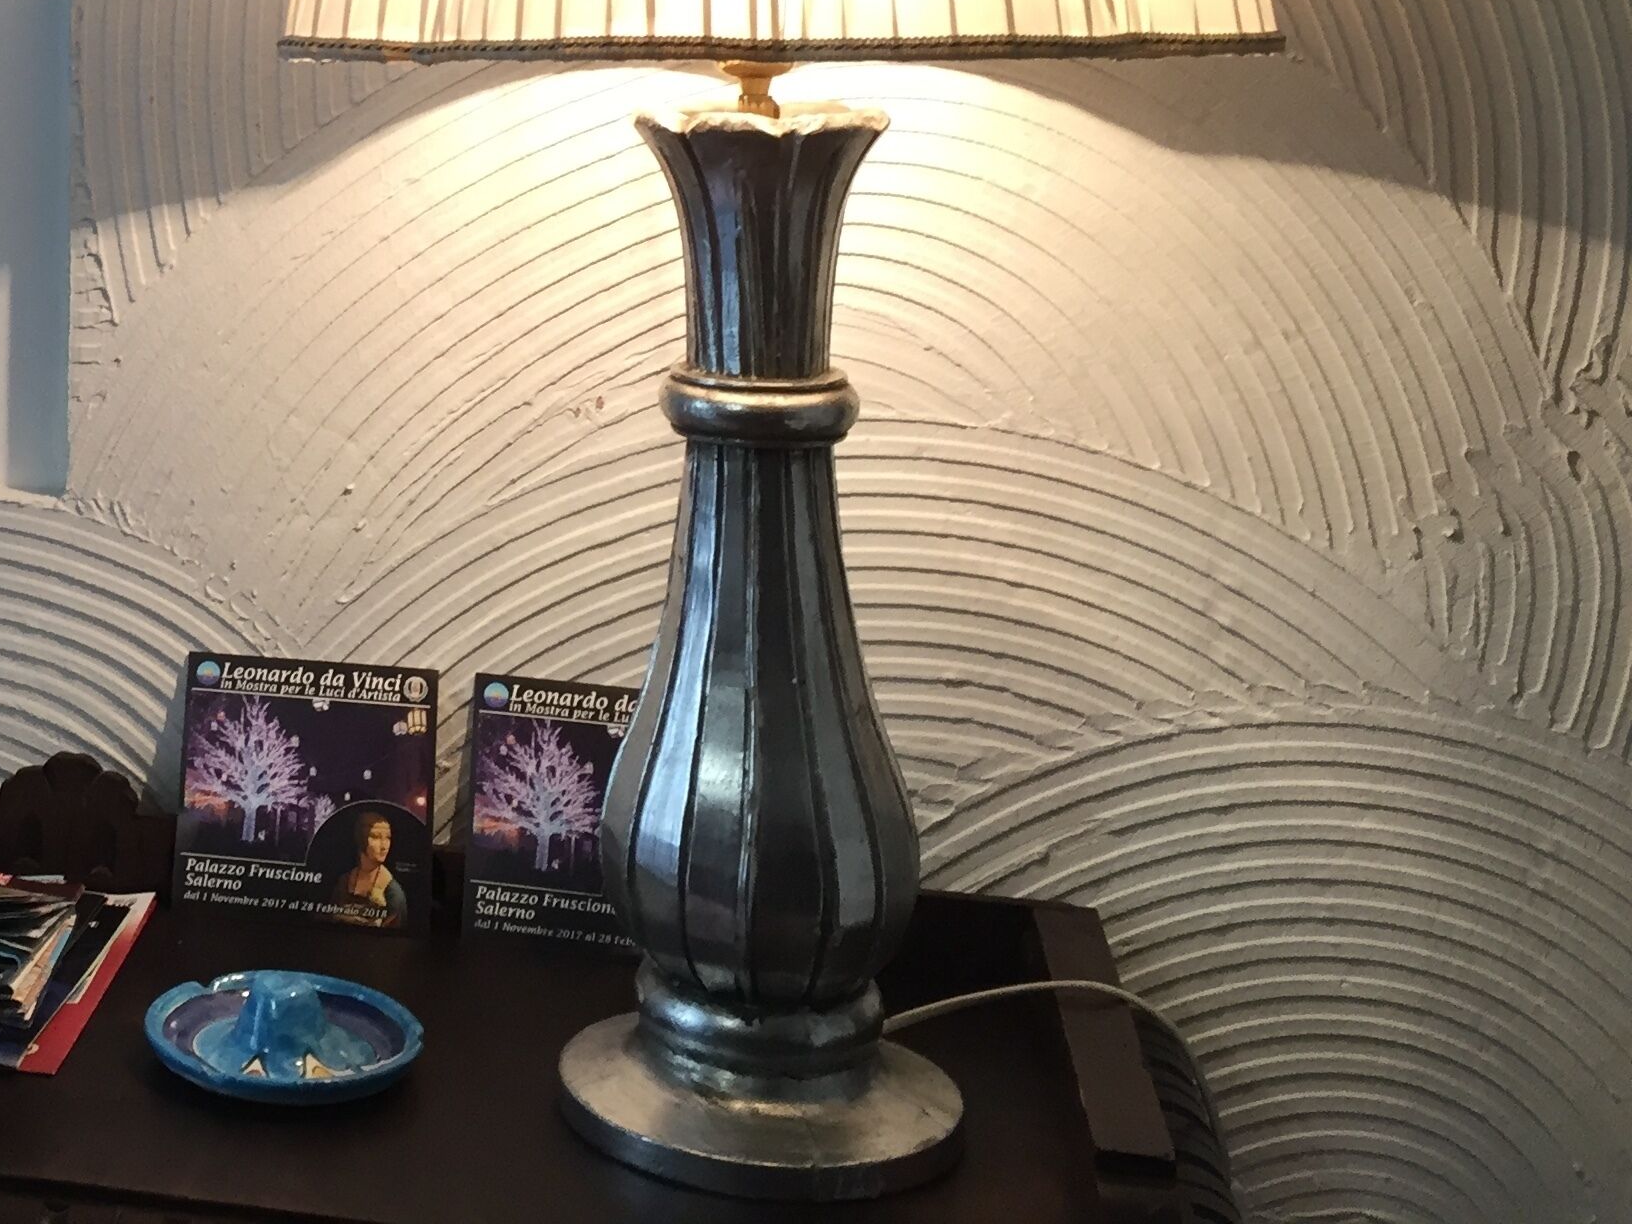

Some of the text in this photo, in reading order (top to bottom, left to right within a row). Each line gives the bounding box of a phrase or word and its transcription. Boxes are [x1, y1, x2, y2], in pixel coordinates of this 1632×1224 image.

[221, 662, 402, 691] Leonardo da Vinci
[235, 679, 277, 693] Mostra
[280, 684, 301, 696] per
[305, 683, 316, 696] le
[319, 686, 345, 699] Luci
[347, 687, 401, 702] d'Artista
[510, 684, 609, 710] Leonardo
[525, 702, 569, 717] Mostra
[572, 708, 594, 720] per
[598, 710, 609, 721] le
[184, 873, 242, 890] Salerno
[185, 857, 322, 884] Palazzo Fruscione
[183, 890, 200, 901] dal
[210, 892, 259, 907] Novembre
[263, 897, 286, 909] 2017
[288, 899, 299, 910] al
[316, 902, 360, 916] Febbraio
[362, 906, 388, 919] 2018
[475, 885, 539, 906] Palazzo
[475, 900, 536, 920] Salerno
[474, 918, 491, 929] dal
[502, 922, 554, 937] Novembre
[556, 928, 582, 941] 2017
[584, 930, 596, 942] al
